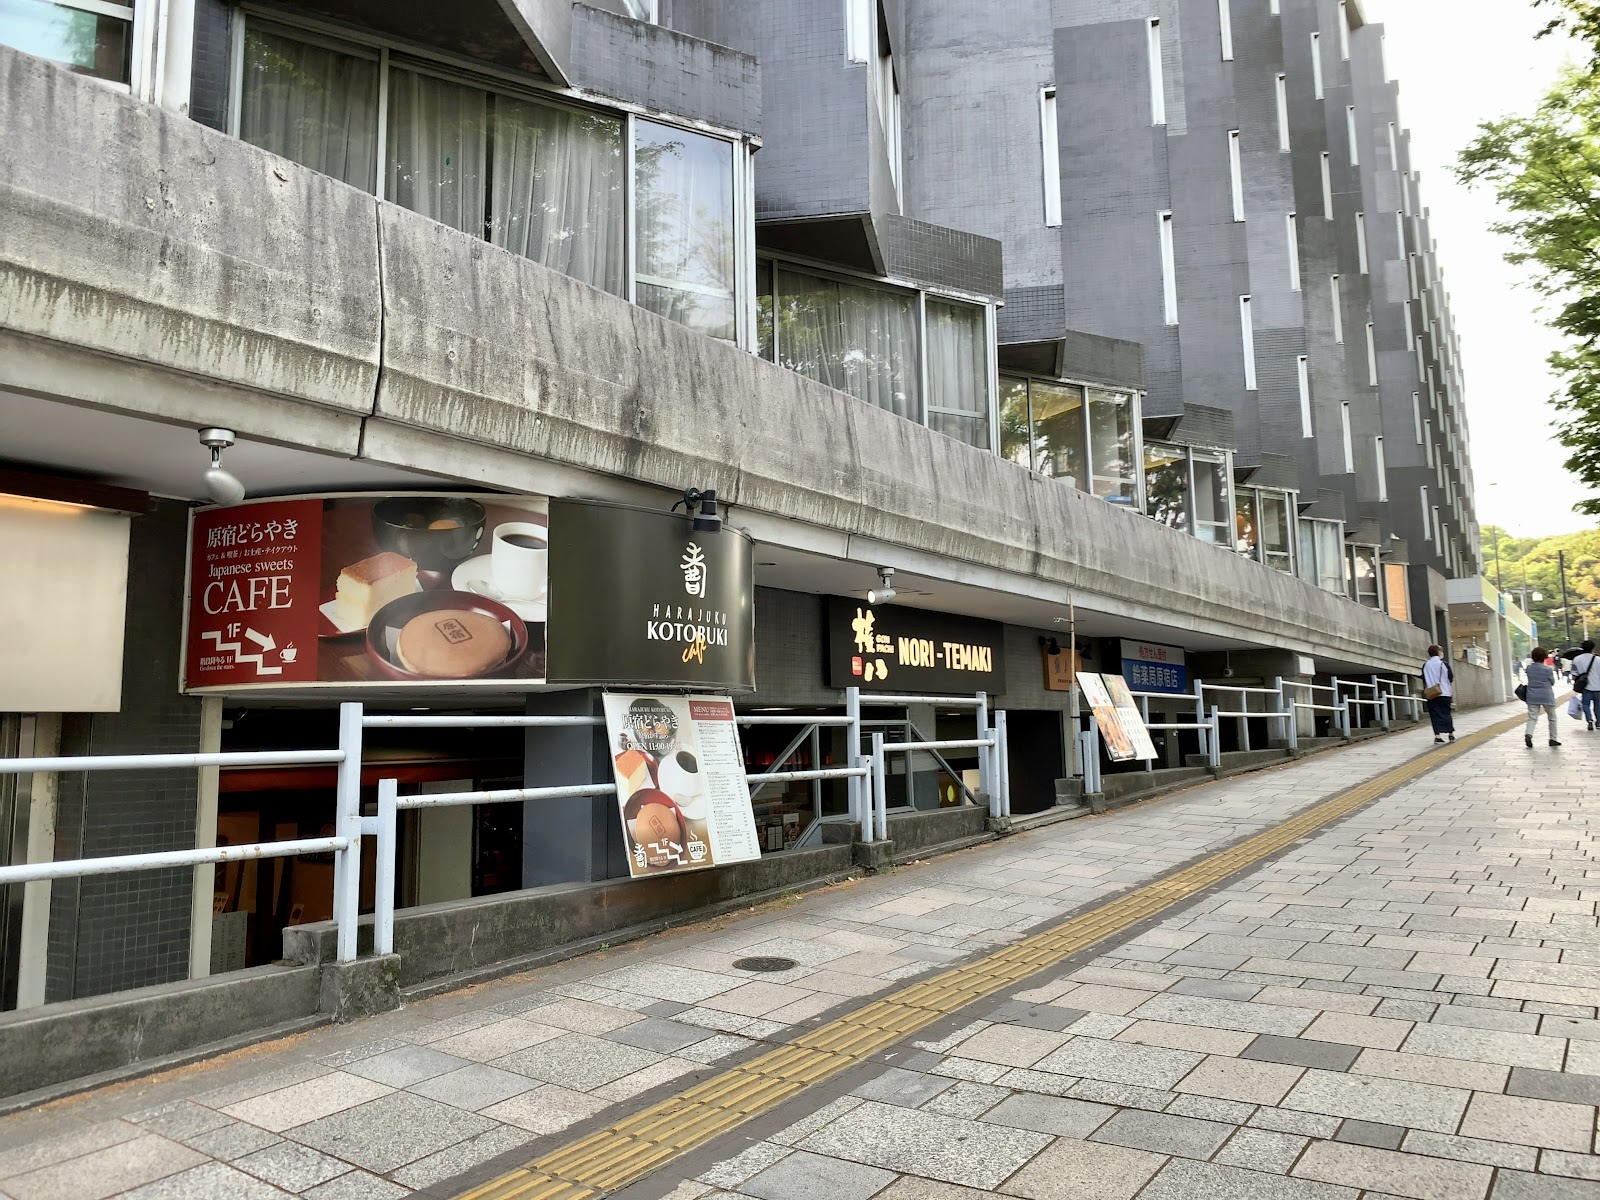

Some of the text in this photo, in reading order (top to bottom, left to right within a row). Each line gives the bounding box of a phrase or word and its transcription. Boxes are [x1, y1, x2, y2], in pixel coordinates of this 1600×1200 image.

[207, 518, 299, 548] 原宿どらやき
[208, 558, 294, 580] Japanese sweets
[203, 575, 293, 615] CAFE
[653, 603, 727, 625] HARAJUKU
[227, 622, 241, 638] 1F
[647, 620, 728, 646] KOTOBUKI
[622, 714, 679, 730] 原宿どらやき
[626, 742, 648, 751] OPEN
[661, 838, 669, 846] 1F
